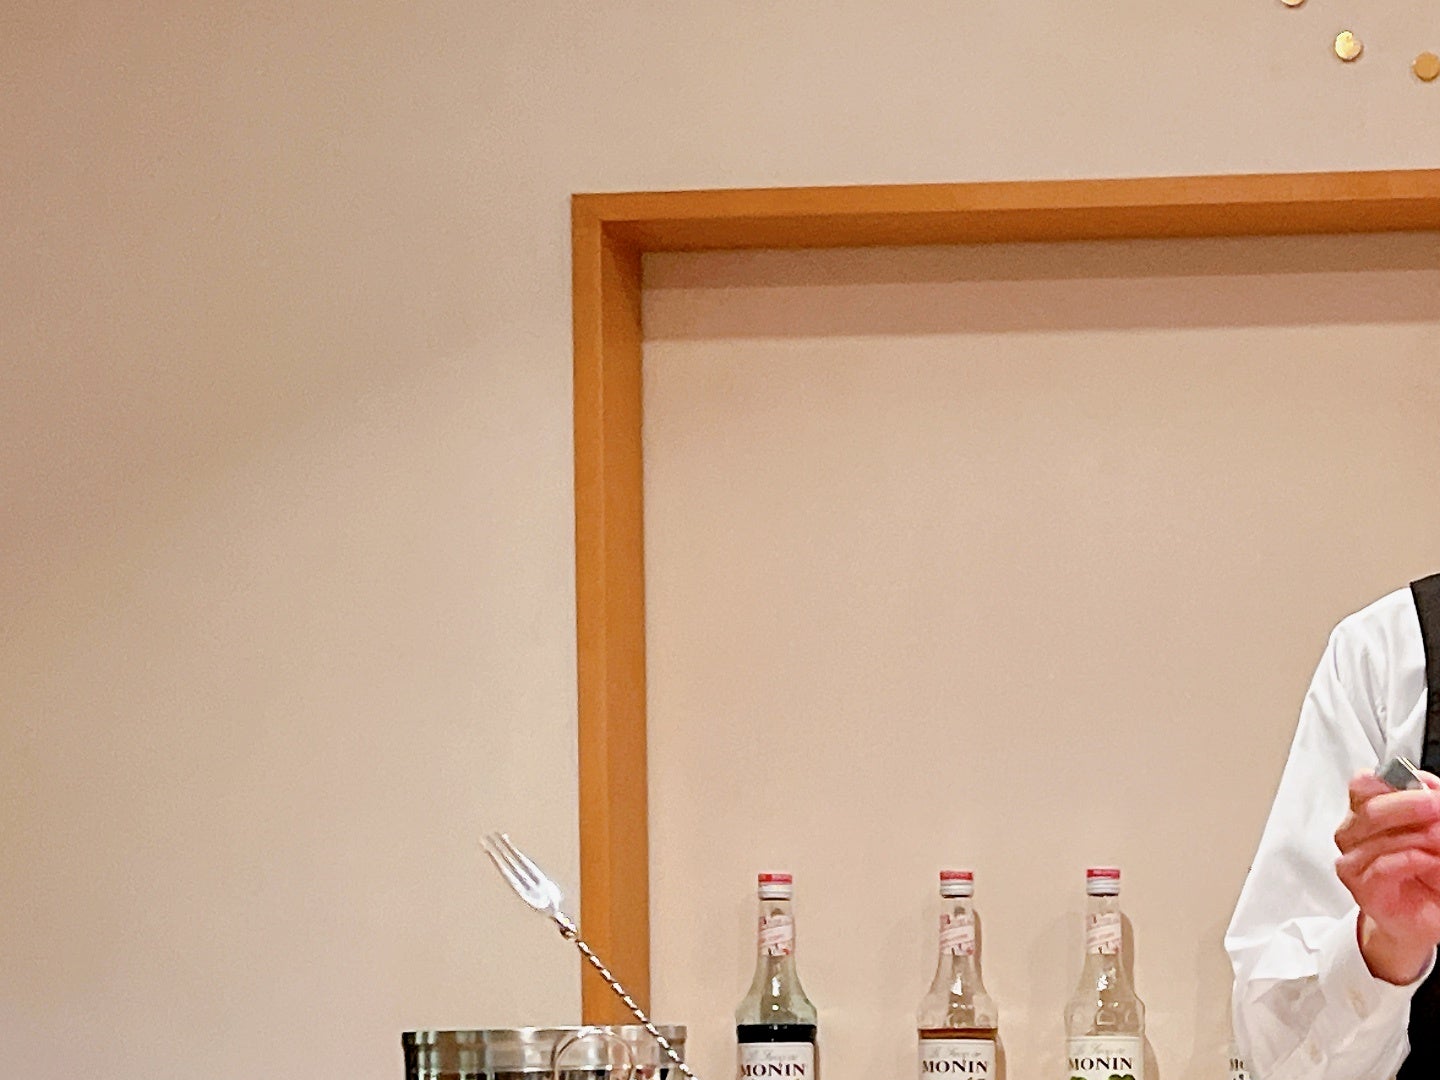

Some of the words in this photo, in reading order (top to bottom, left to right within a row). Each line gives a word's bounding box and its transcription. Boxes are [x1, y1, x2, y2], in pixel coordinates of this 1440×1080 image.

[741, 1063, 806, 1077] MONIN
[922, 1060, 988, 1073] MONIN
[1068, 1057, 1133, 1071] MONIN
